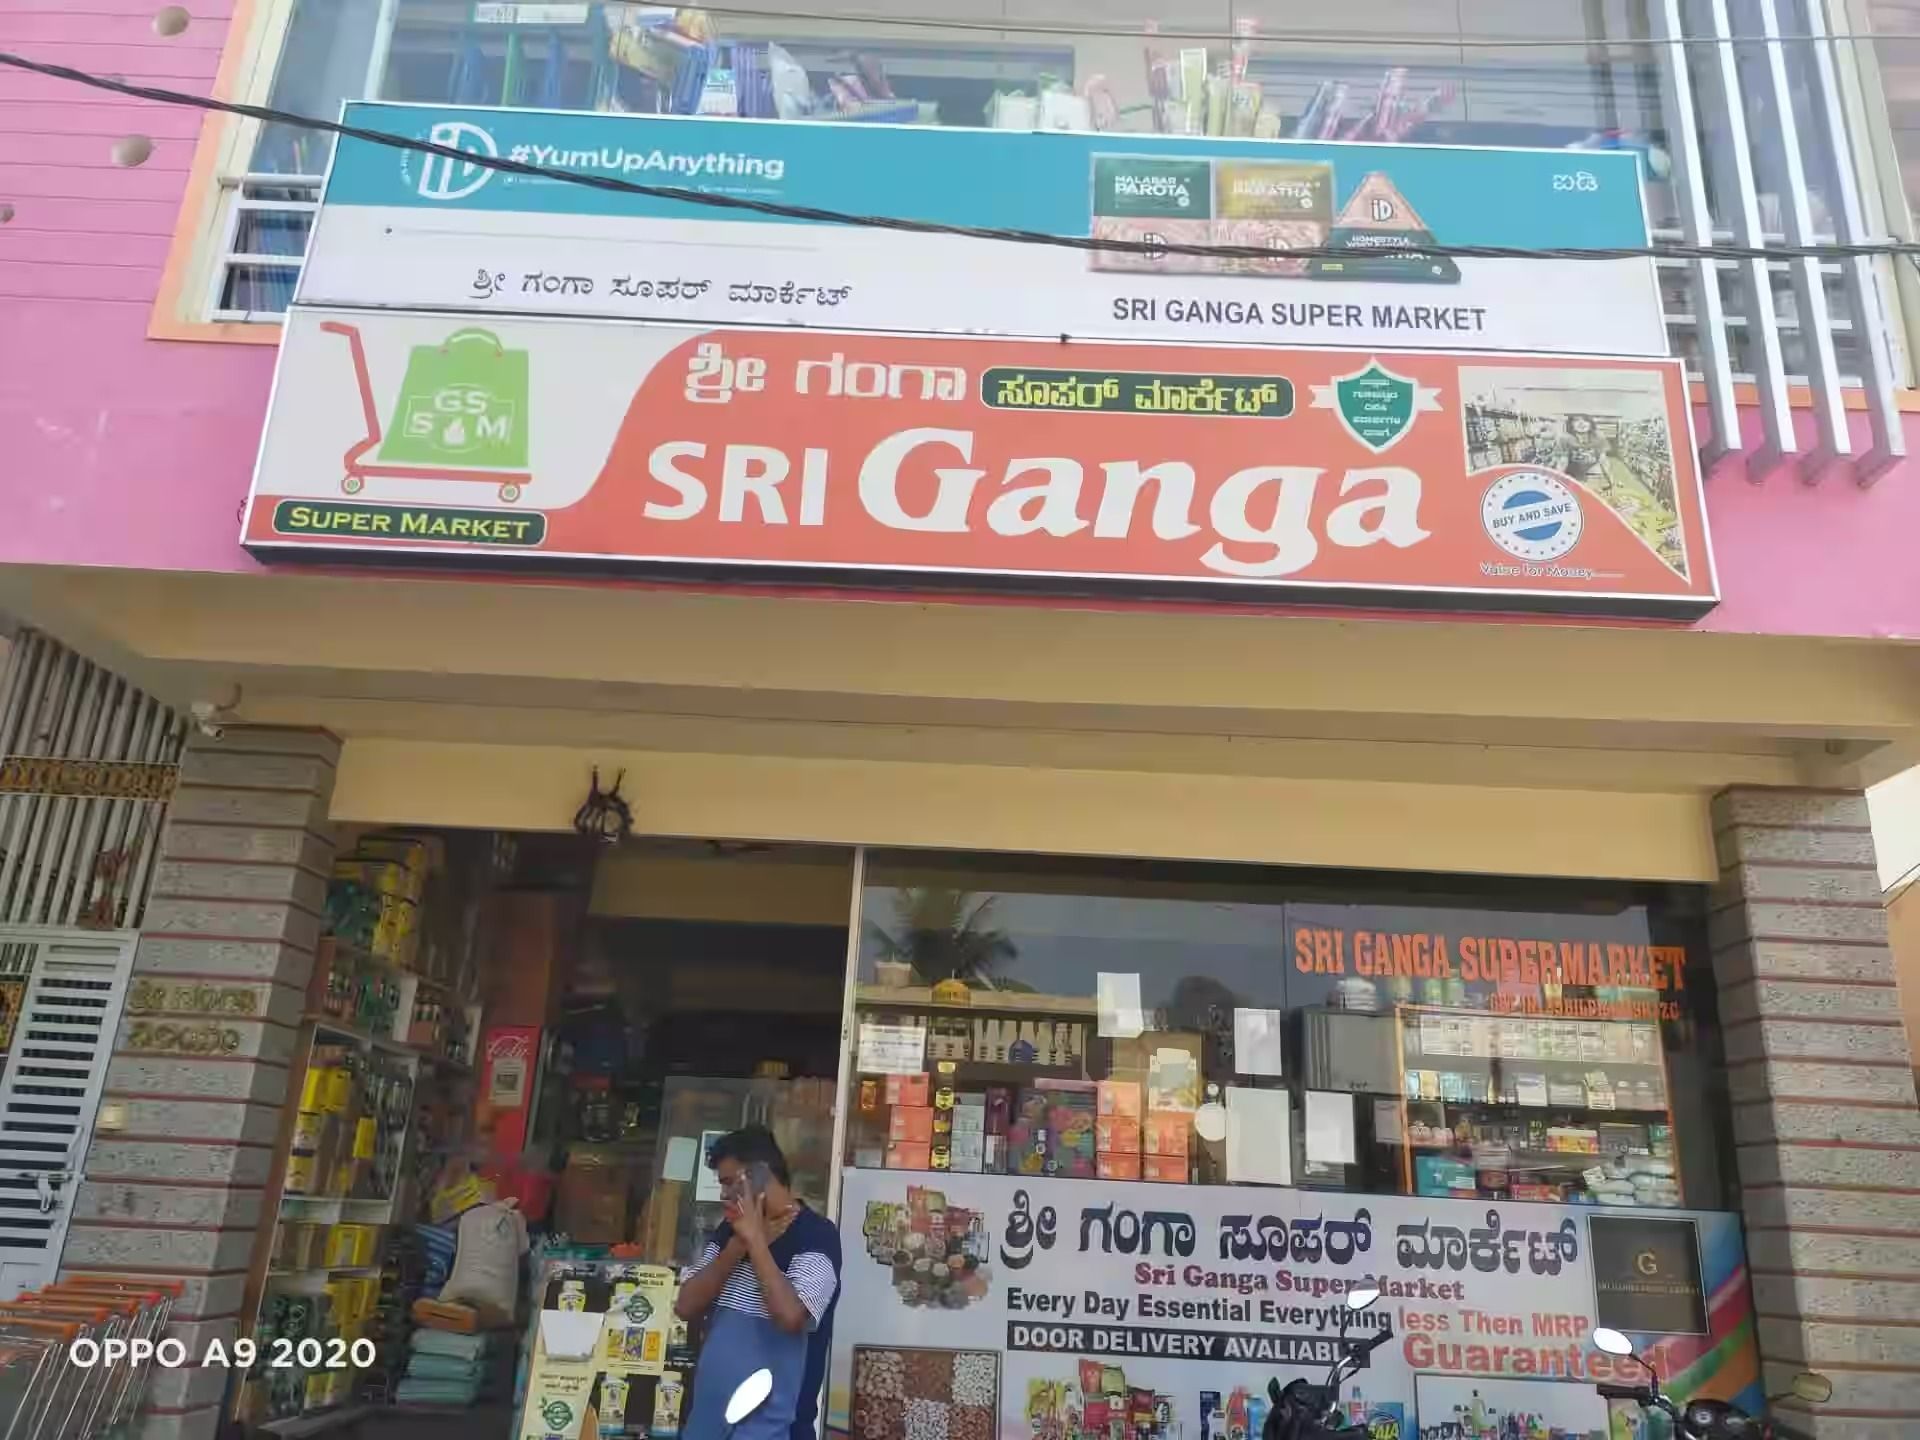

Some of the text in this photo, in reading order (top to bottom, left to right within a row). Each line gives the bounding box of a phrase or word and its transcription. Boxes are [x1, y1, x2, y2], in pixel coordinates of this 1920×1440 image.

[508, 145, 785, 180] #YumUpAnything
[1115, 183, 1190, 198] PAROTA
[469, 269, 506, 299] ಶ್ರೀ
[521, 270, 594, 296] ಗಂಗಾ
[610, 275, 712, 301] ಸೂಪರ್
[1112, 298, 1487, 332] SRI GANGA SUPER MARKET
[685, 342, 968, 404] ಶ್ರೀ ಗಂಗಾ
[997, 374, 1120, 408] ಸೂಪರ್
[642, 427, 1432, 577] SRI Ganga
[1492, 502, 1573, 529] BUY AND SAVE
[1480, 561, 1520, 577] Value
[1295, 928, 1344, 974] SRI
[1353, 932, 1451, 978] GANGA
[1000, 1189, 1057, 1270] ಶ್ರೀ
[1078, 1201, 1196, 1257] ಗಂಗಾ
[1219, 1206, 1373, 1265] ಸೂಪರ್
[1135, 1262, 1176, 1286] Sri
[1183, 1265, 1268, 1294] Ganga
[1007, 1287, 1589, 1338] Every Day Essential Everything less Then MRP
[1014, 1326, 1358, 1364] DOOR DELIVERY AVALIABL
